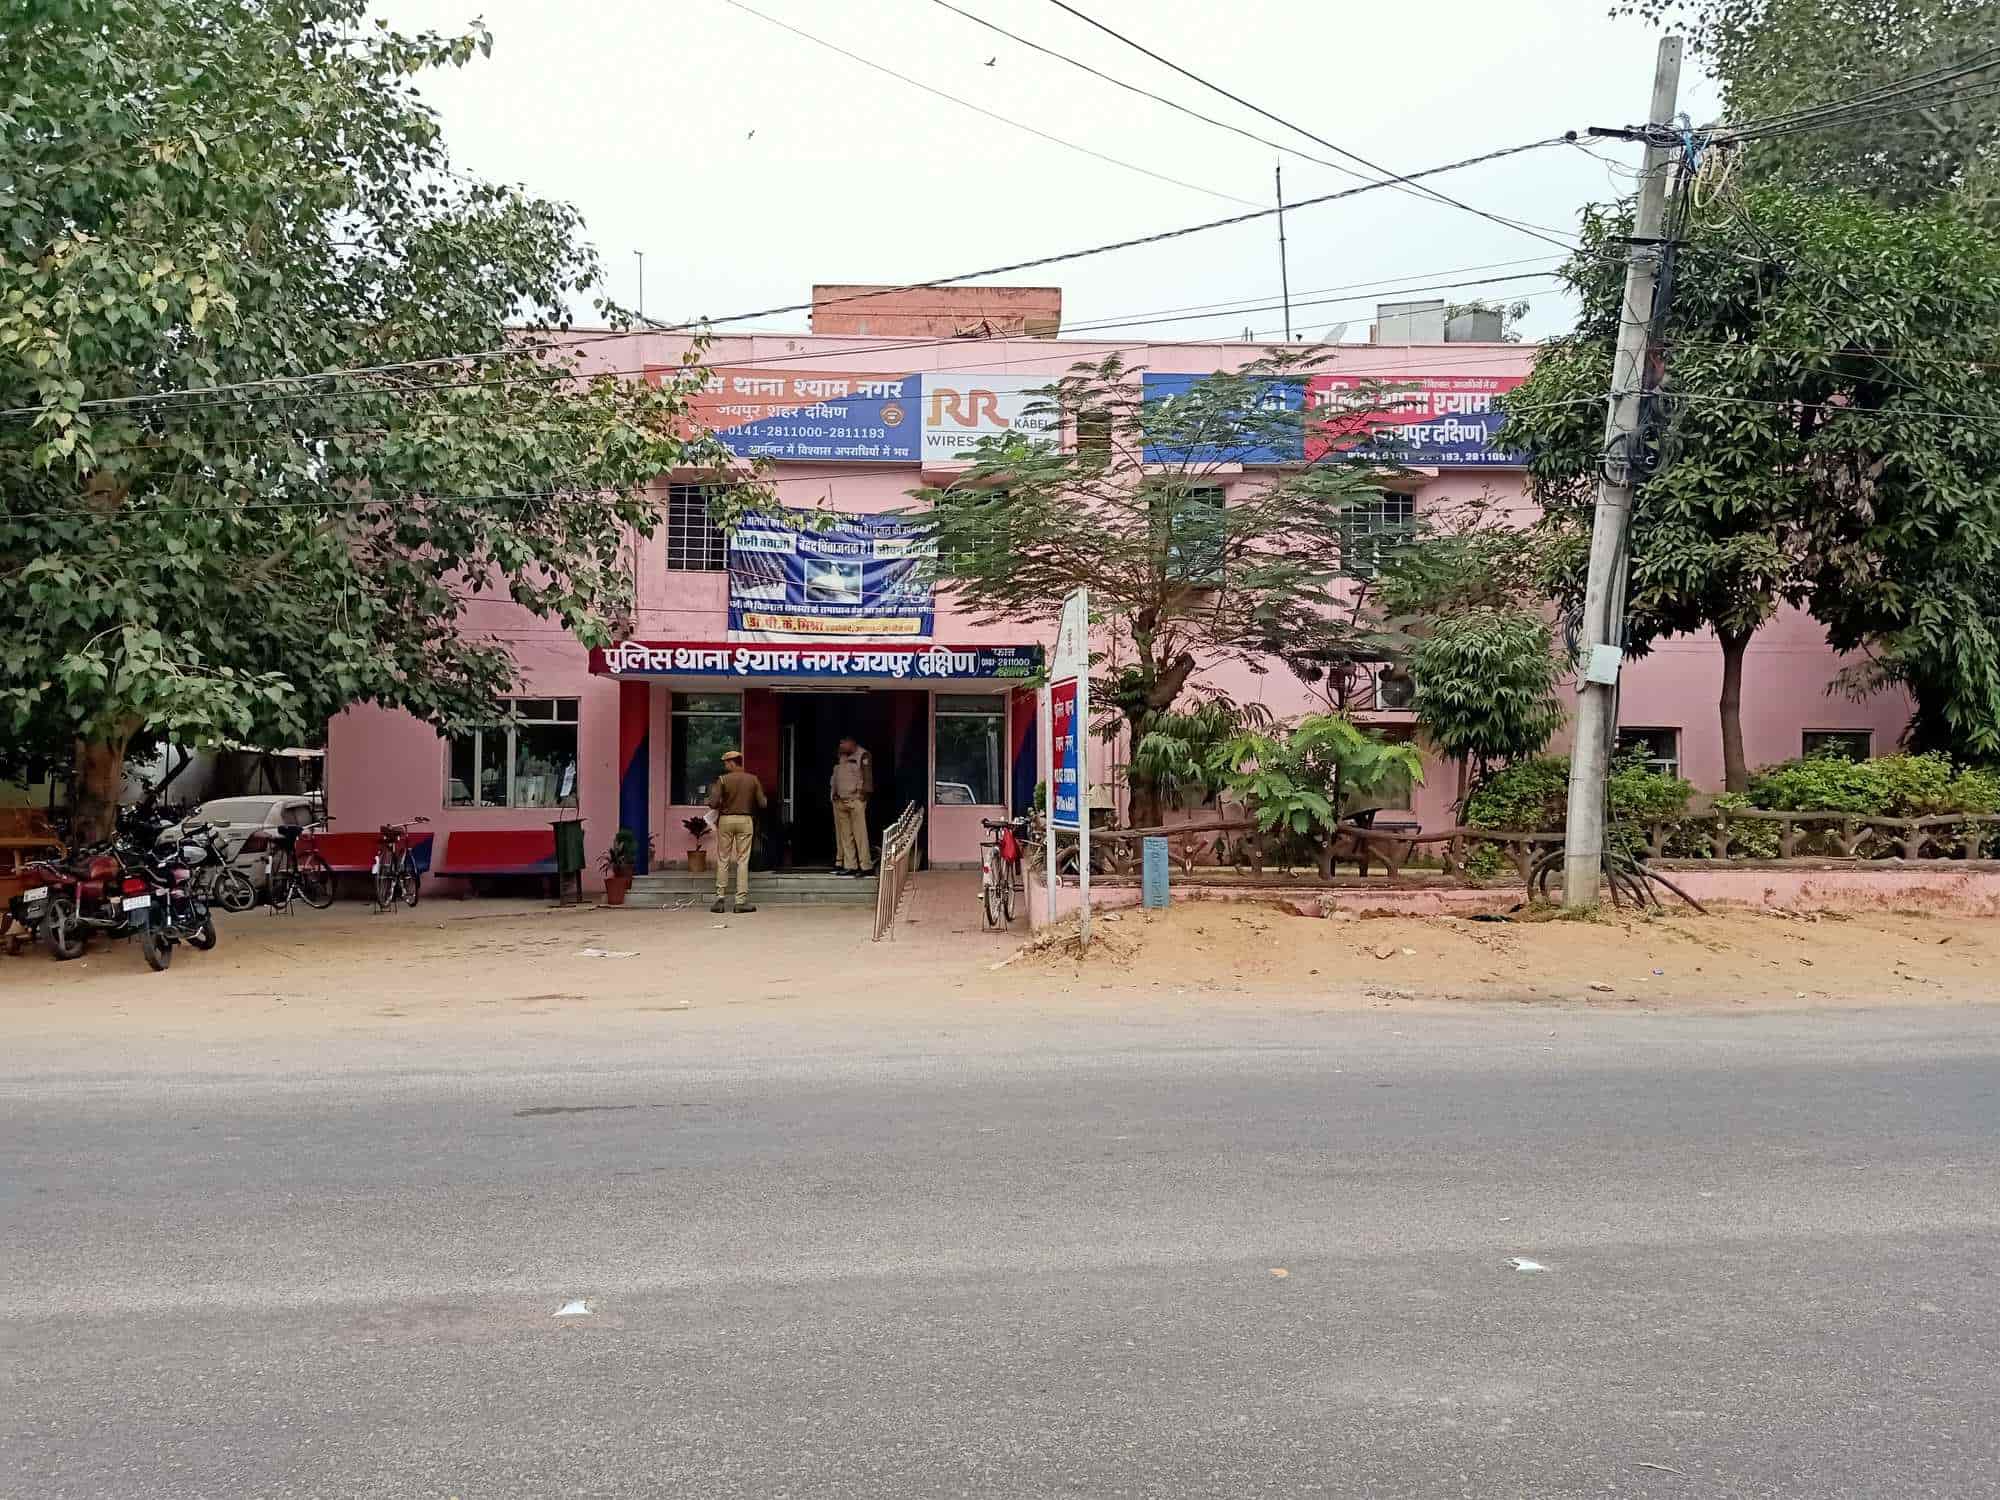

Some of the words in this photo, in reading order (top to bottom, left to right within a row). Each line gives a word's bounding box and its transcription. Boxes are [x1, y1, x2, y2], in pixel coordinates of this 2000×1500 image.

[733, 376, 786, 396] थाना
[794, 379, 850, 397] श्याम
[856, 381, 903, 398] नगर
[716, 405, 761, 421] जयपुर
[767, 405, 799, 419] शहर
[805, 402, 848, 419] दक्षिण
[927, 388, 1009, 427] RR
[1433, 393, 1491, 415] श्याम
[728, 426, 885, 439] 0141-2811000-2811193
[926, 435, 975, 447] WIRES
[798, 443, 832, 455] विश्वास
[602, 642, 674, 674] पुलिस
[675, 648, 732, 671] थाना
[733, 648, 801, 675] श्याम
[801, 651, 850, 674] नगर
[851, 651, 914, 677] जयपुर
